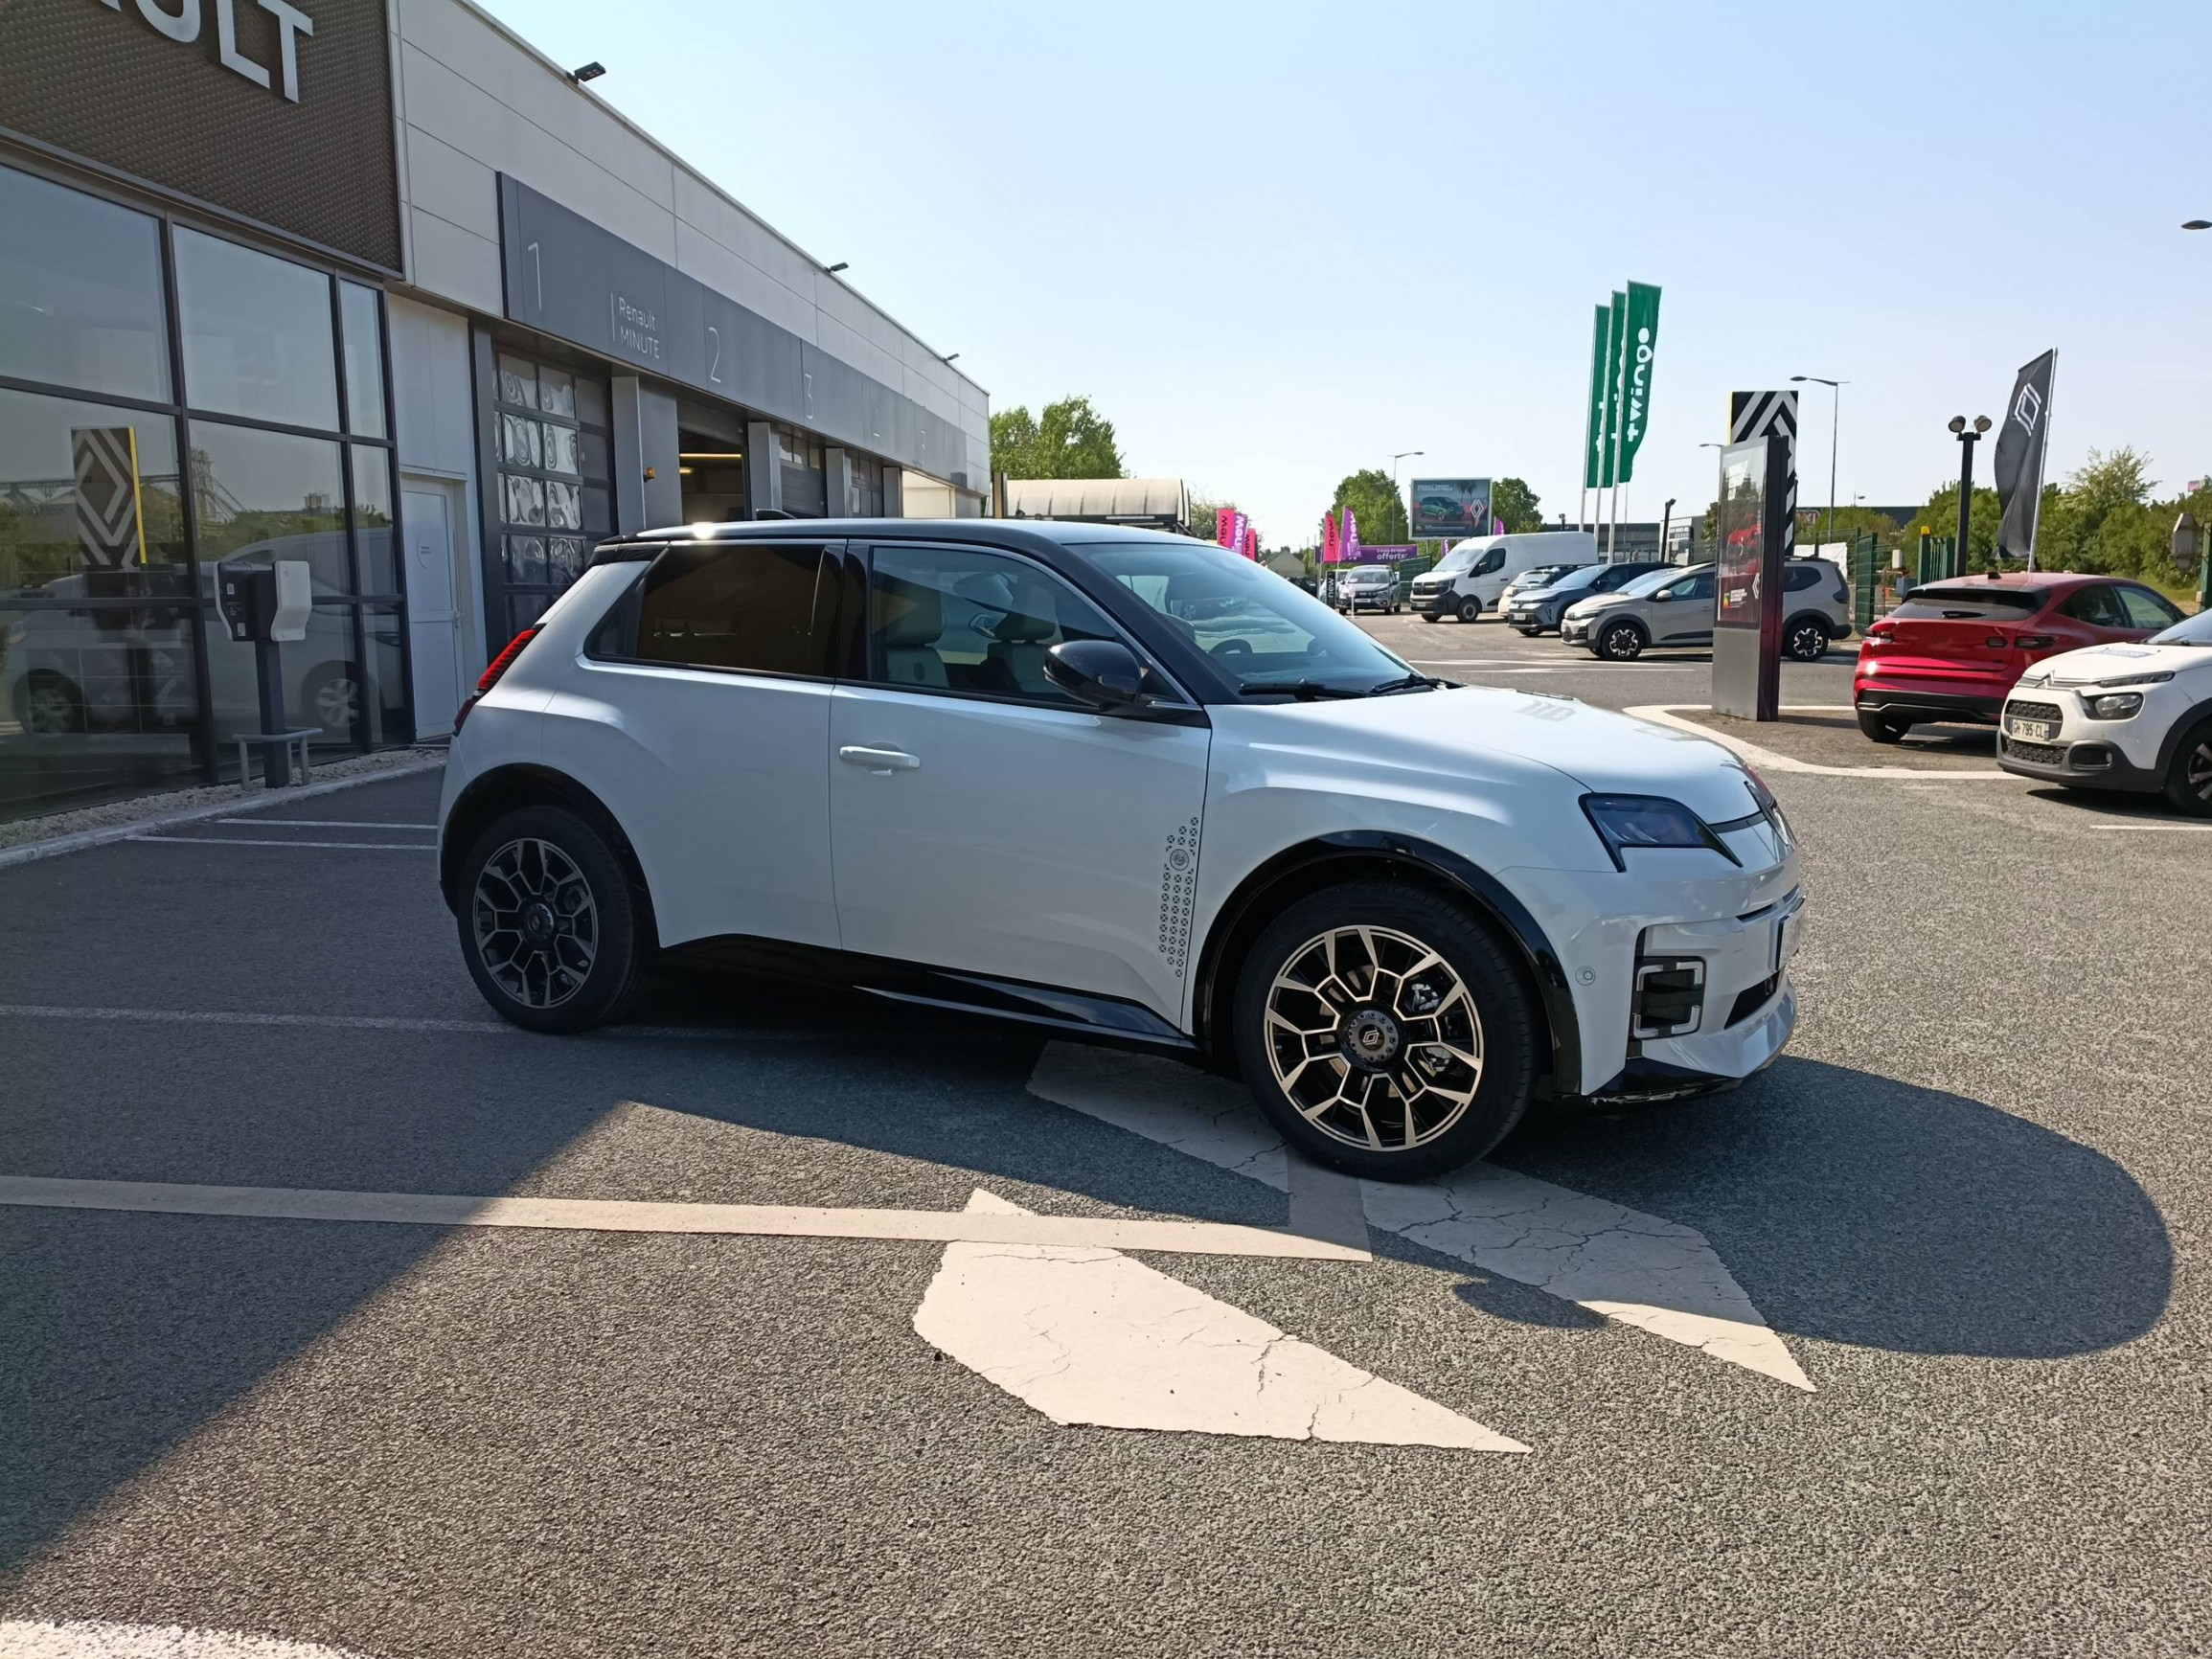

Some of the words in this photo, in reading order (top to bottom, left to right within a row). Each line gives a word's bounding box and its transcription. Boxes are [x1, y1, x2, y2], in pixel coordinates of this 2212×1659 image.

[100, 0, 313, 103] LT
[527, 241, 542, 313] 1
[619, 296, 656, 331] Renault
[620, 325, 660, 359] MINUTE
[708, 326, 721, 383] 2
[805, 373, 814, 420] 3
